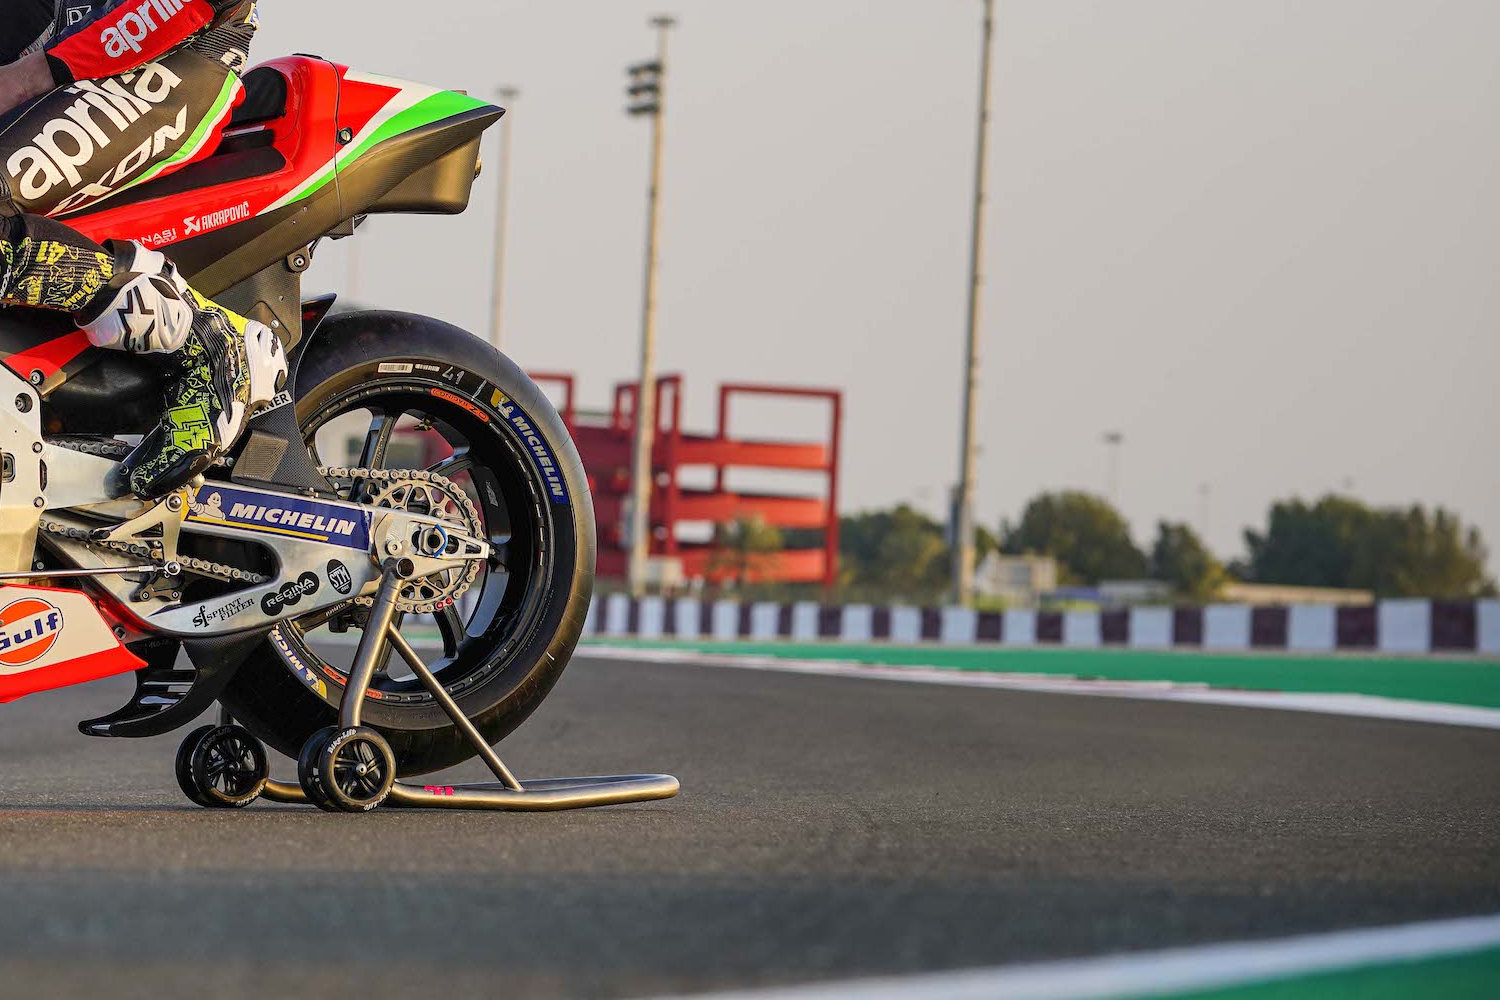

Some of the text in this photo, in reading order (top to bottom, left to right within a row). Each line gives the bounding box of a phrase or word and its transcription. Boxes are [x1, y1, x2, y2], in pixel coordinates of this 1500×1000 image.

[6, 62, 182, 200] aprilia
[441, 366, 465, 385] 41
[511, 416, 564, 497] MICHELIN
[229, 503, 356, 535] MICHELIN
[330, 565, 351, 588] STM
[266, 578, 315, 608] REGINA
[207, 597, 242, 621] SPRINT
[220, 598, 256, 621] FILTER
